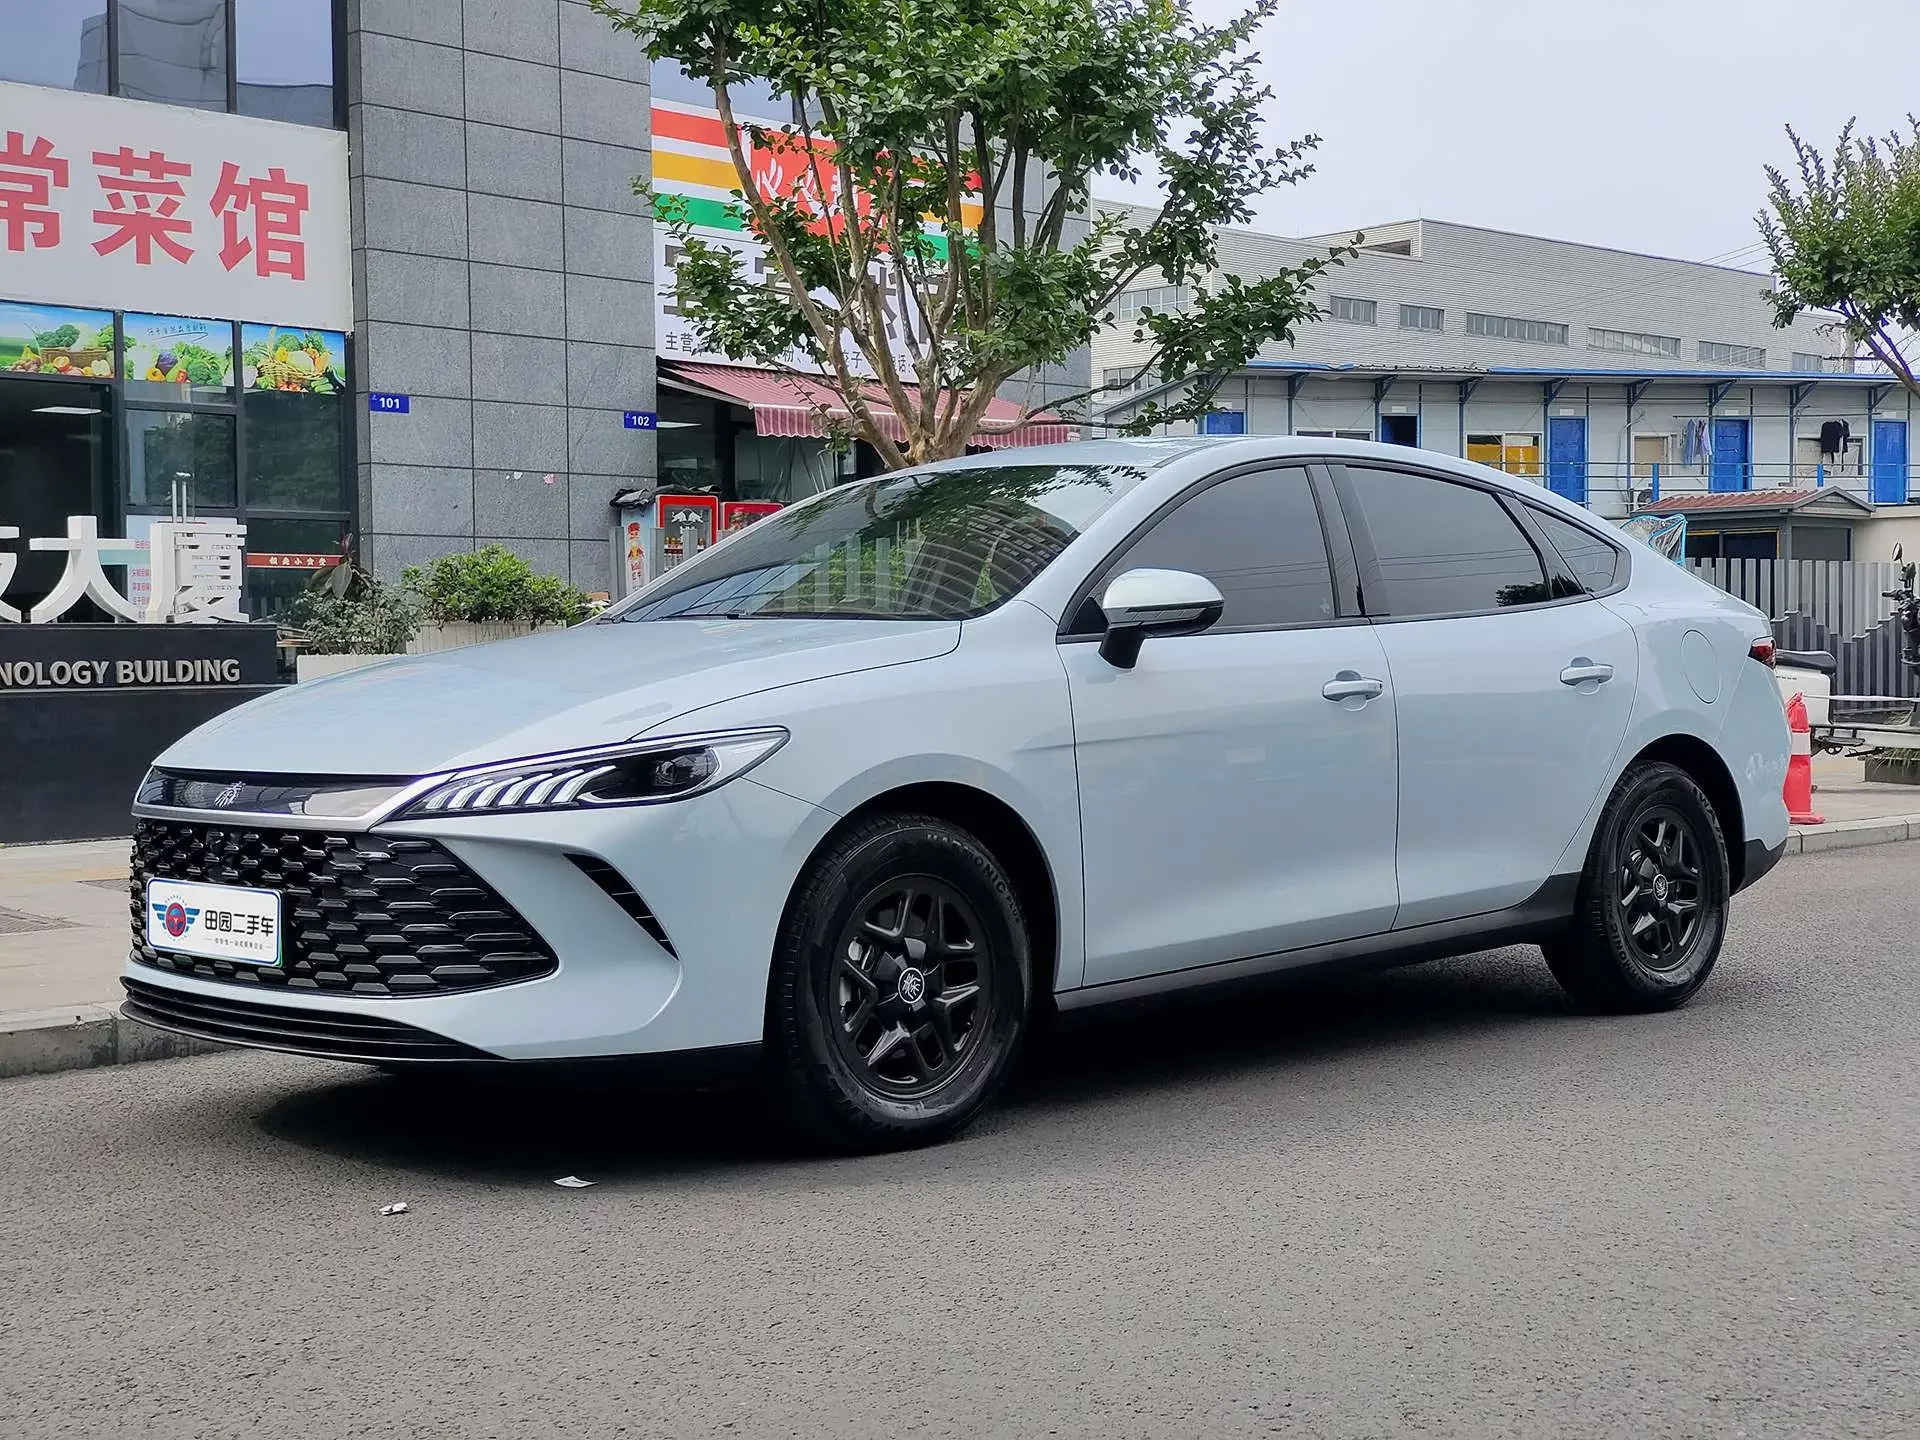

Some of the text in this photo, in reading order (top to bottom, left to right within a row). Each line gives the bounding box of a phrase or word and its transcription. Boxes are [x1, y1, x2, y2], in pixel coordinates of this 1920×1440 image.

[0, 130, 309, 281] 常菜馆
[379, 397, 400, 409] 101
[631, 415, 650, 427] 102
[0, 515, 249, 625] 大厦
[116, 659, 240, 684] BUILDING
[204, 909, 275, 938] 田园二手车
